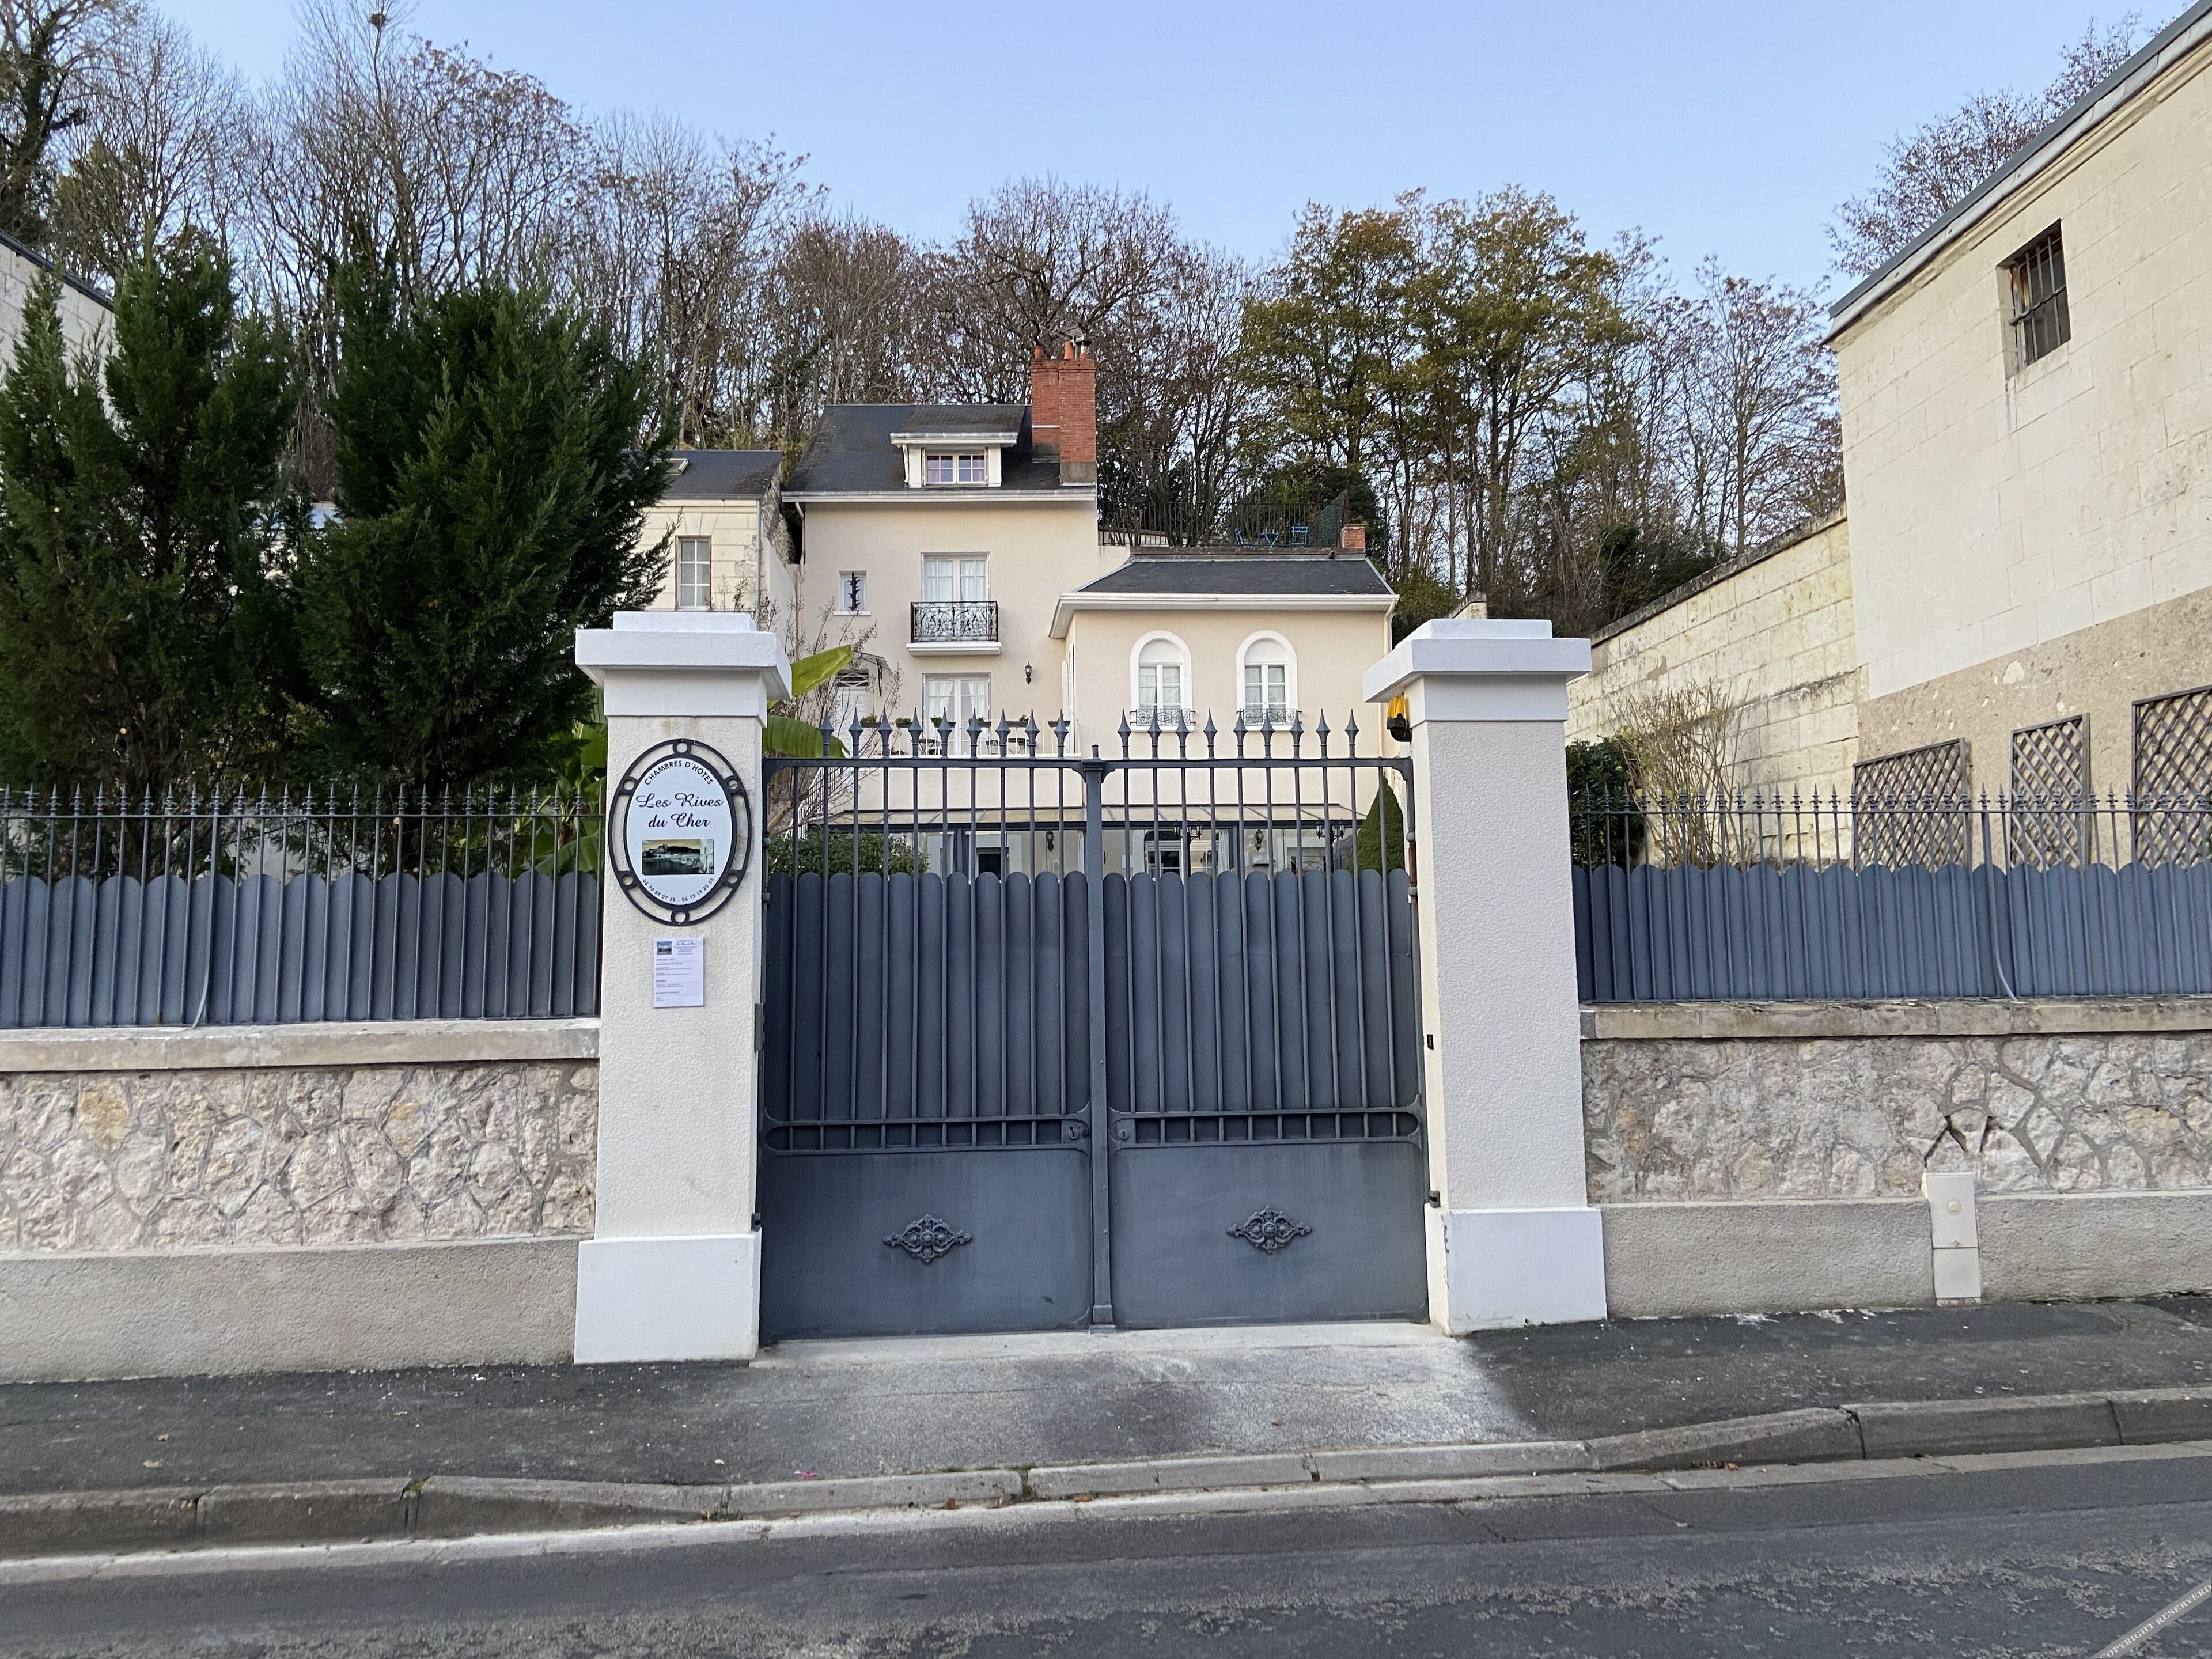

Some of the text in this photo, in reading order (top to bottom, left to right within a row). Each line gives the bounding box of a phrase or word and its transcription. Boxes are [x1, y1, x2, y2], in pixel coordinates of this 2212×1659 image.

[645, 760, 713, 785] CHAMBRES D'HÔTES
[636, 793, 724, 808] Les Rives
[648, 812, 711, 827] du Cher
